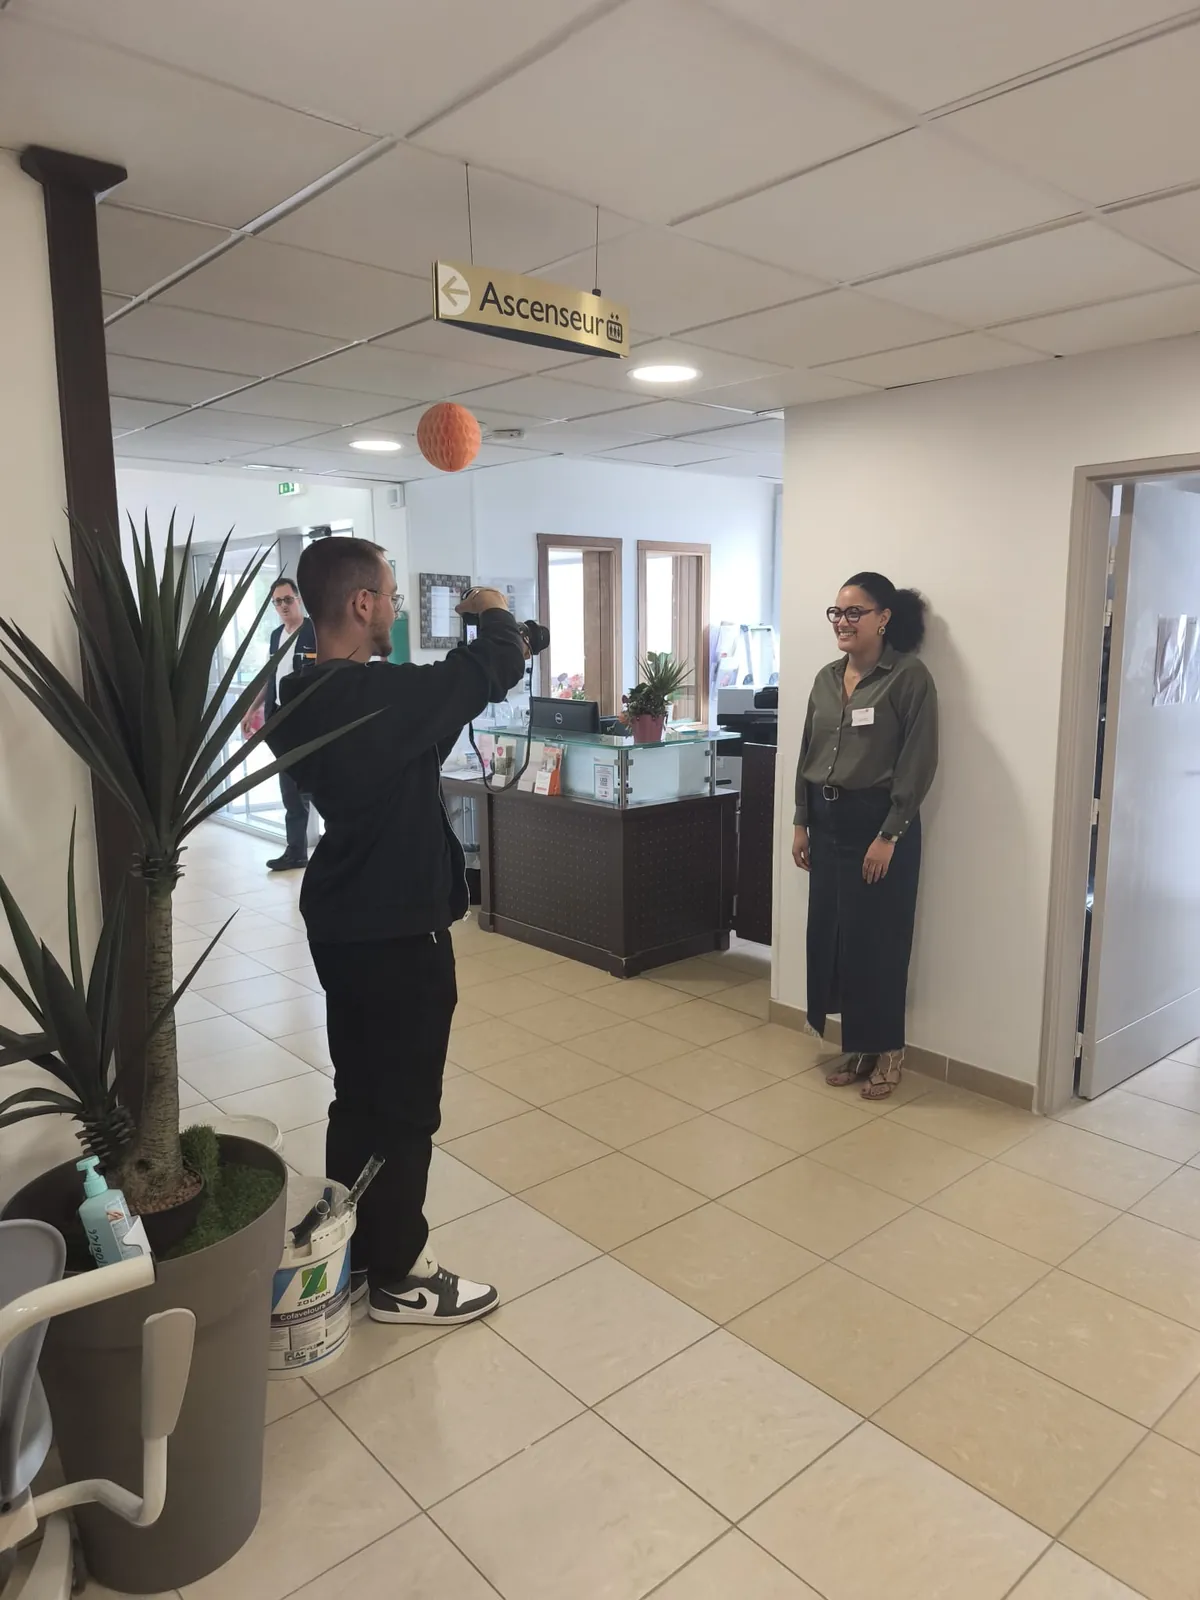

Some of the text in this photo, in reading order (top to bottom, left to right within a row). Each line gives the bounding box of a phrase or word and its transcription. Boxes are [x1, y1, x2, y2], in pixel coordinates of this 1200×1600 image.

[479, 281, 604, 336] Ascenseur
[297, 1290, 331, 1306] ZOLPAN
[280, 1304, 326, 1320] Cofavelours
